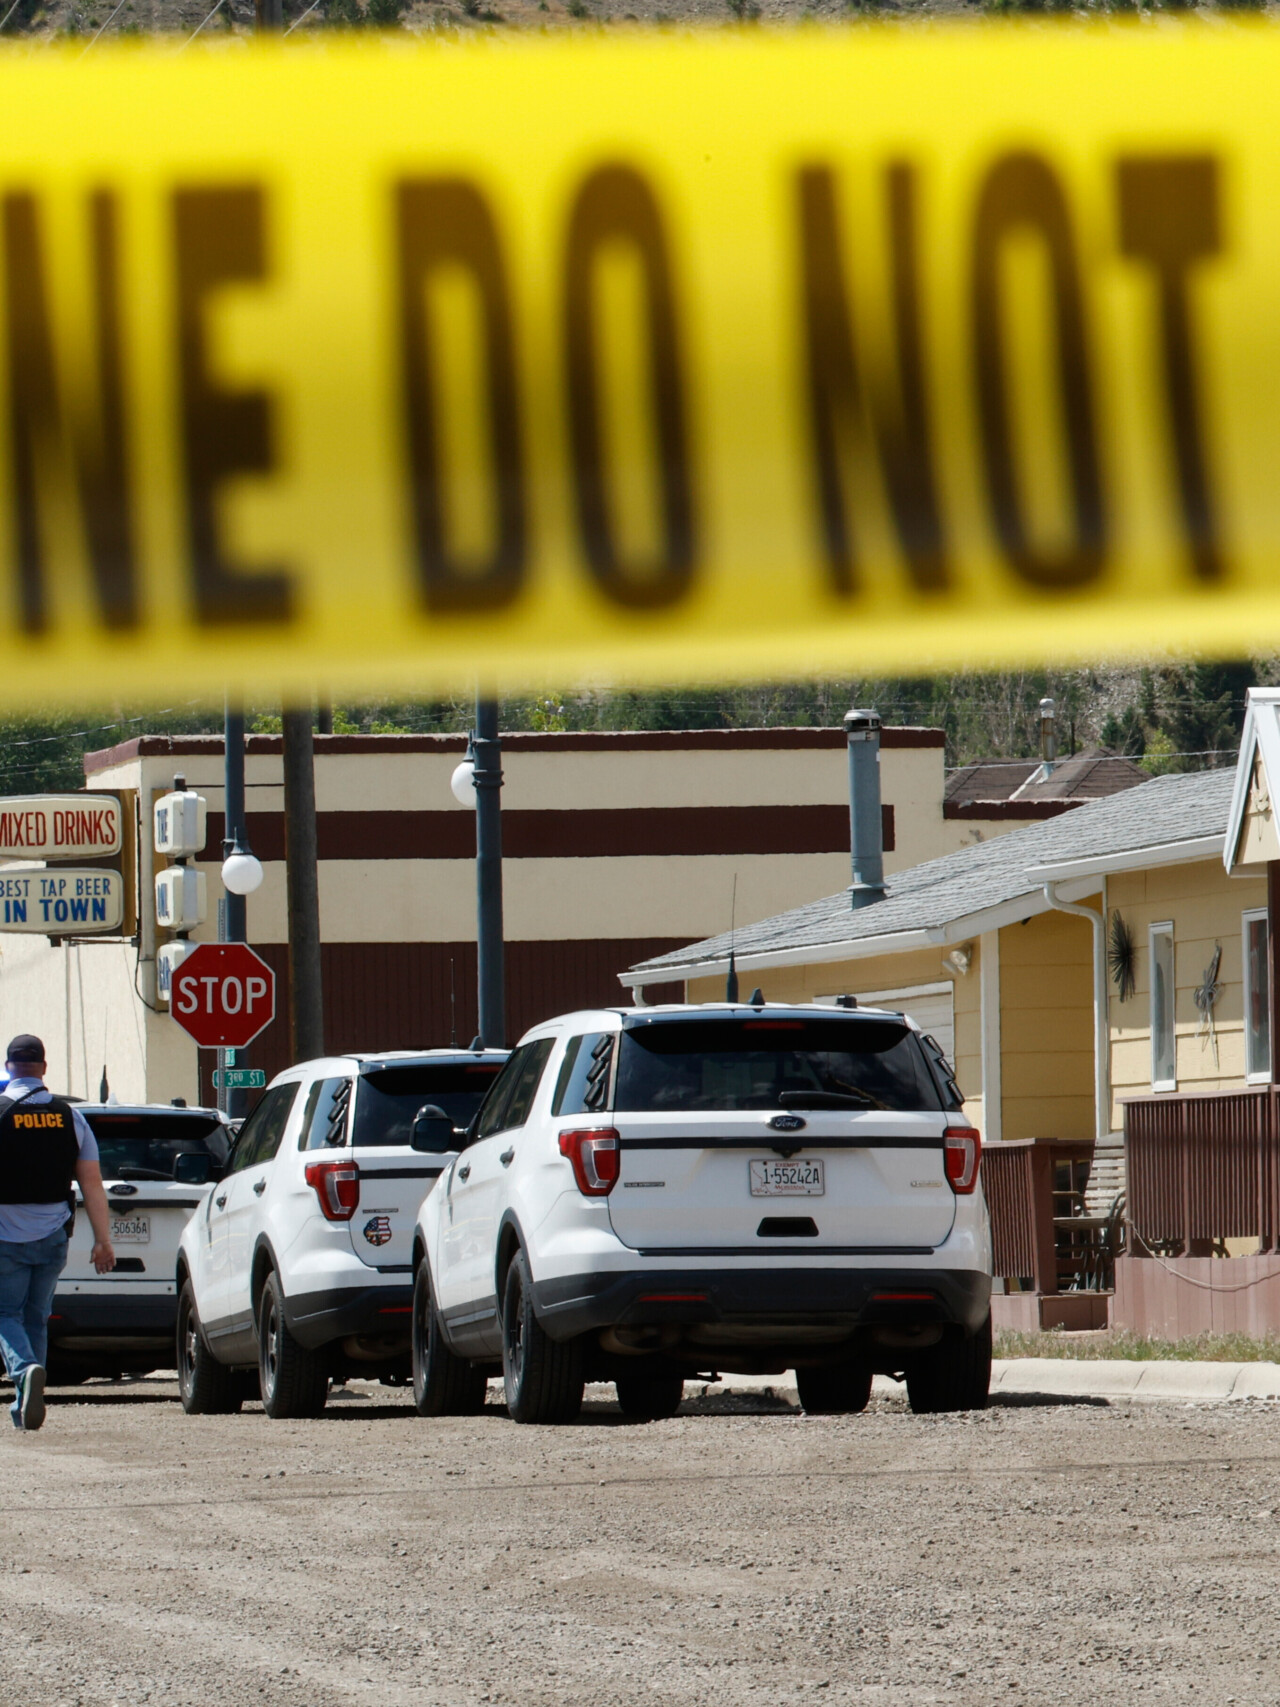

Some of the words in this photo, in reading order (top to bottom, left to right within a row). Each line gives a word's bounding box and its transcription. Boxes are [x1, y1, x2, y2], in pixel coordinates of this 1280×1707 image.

[390, 158, 700, 623] DO
[794, 150, 1226, 600] NOT
[53, 810, 116, 846] DRINKS
[40, 878, 67, 897] TAP
[76, 877, 111, 896] BEER
[4, 899, 27, 923] IN
[39, 898, 106, 922] TOWN
[177, 976, 267, 1015] STOP
[249, 1071, 260, 1086] ST
[13, 1113, 64, 1129] POLICE
